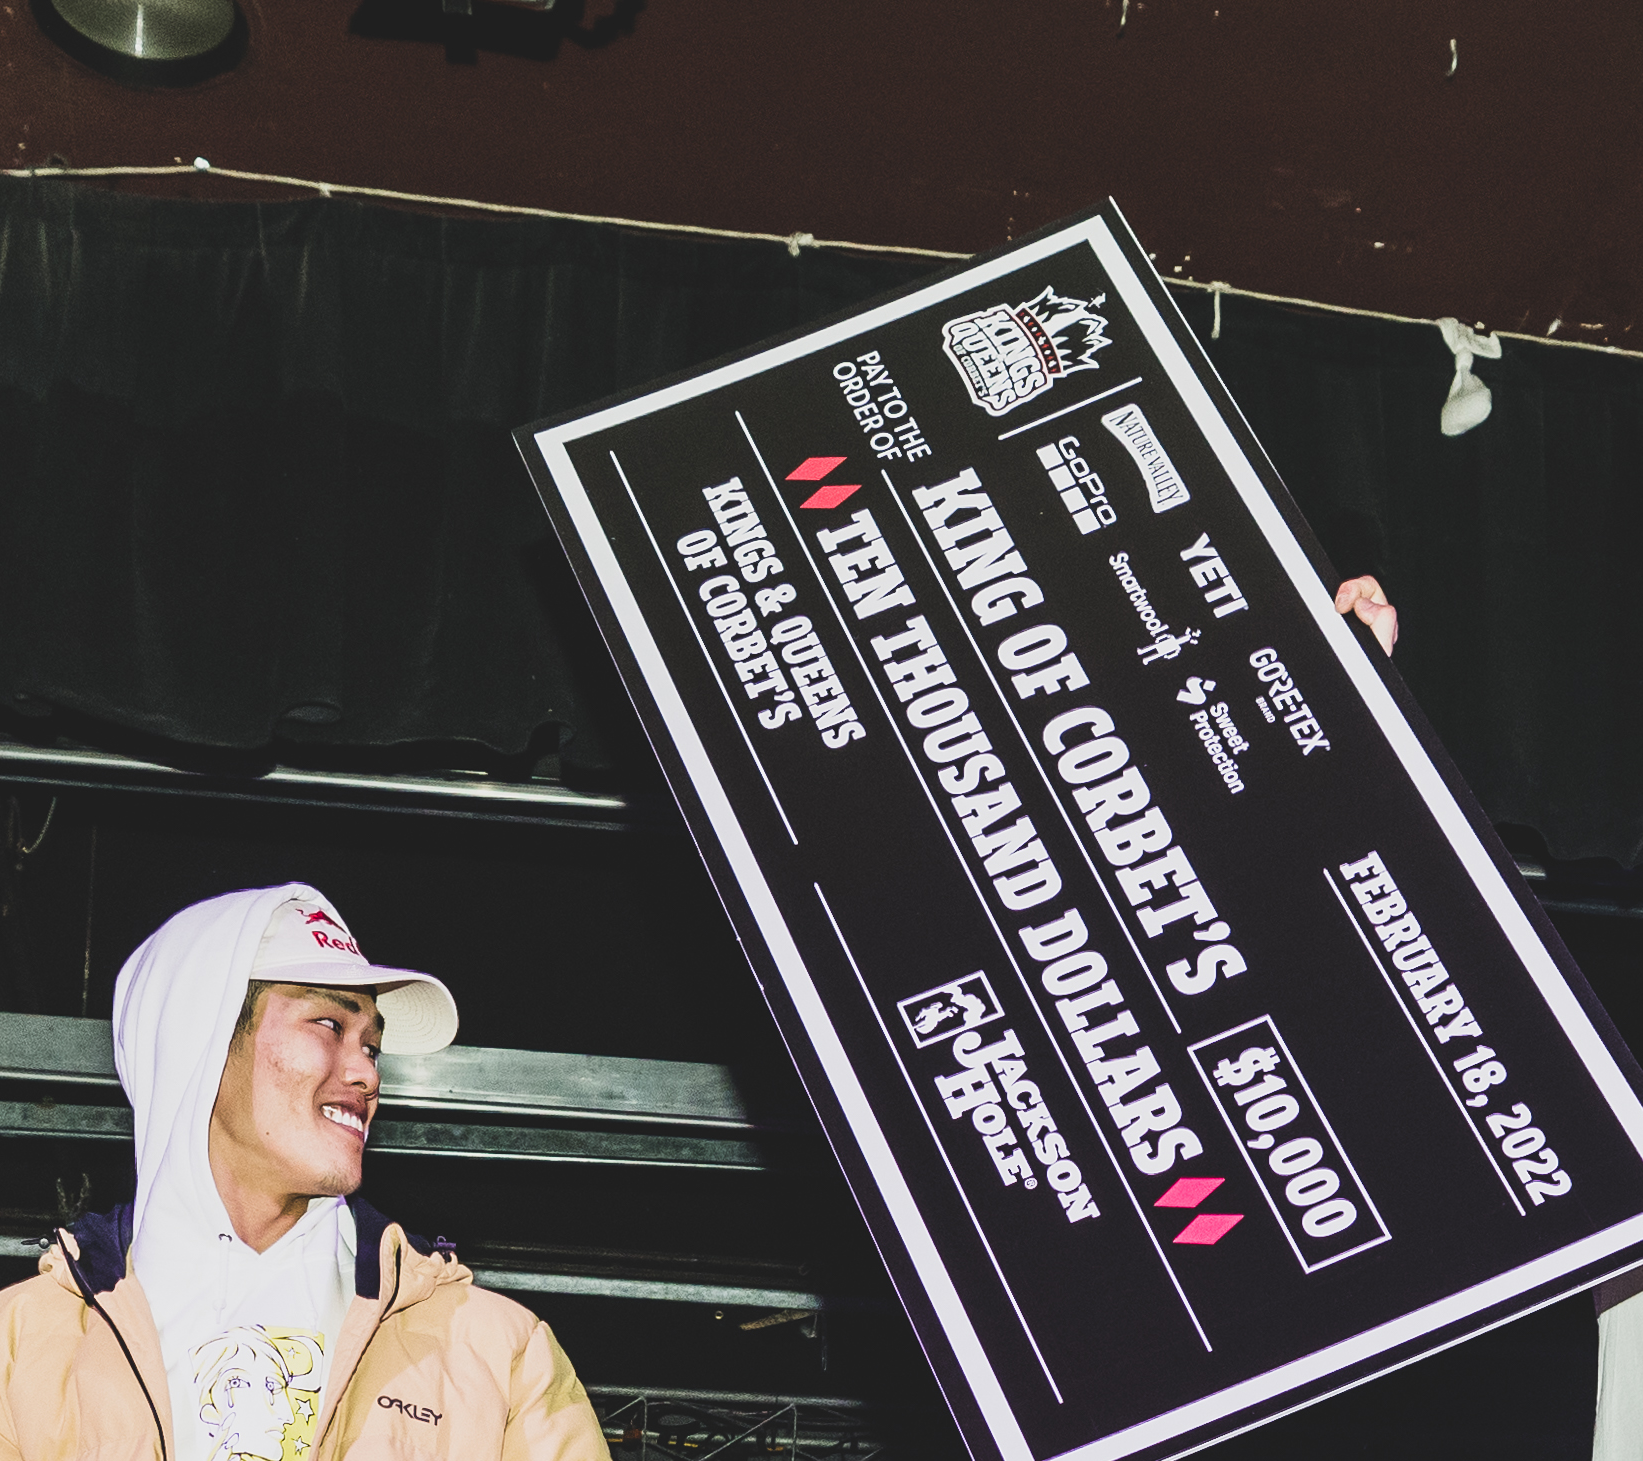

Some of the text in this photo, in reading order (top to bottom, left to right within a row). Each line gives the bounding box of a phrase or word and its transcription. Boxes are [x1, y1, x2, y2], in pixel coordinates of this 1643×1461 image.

[951, 322, 1016, 410] QUEENS
[953, 344, 989, 397] OF CORBET'S
[975, 311, 1046, 397] KINGS
[833, 362, 902, 459] ORDER OF
[857, 351, 932, 462] PAY TO THE
[1059, 436, 1116, 527] GoPro
[1109, 411, 1183, 504] NATURE VALLEY
[702, 477, 866, 748] KINGS & QUEENS
[1109, 553, 1169, 637] Smartwool
[1180, 533, 1247, 618] YETI
[677, 530, 802, 729] OF CORBET'S
[912, 467, 1247, 995] KING OF CORBET'S
[1210, 702, 1249, 754] Sweet
[1250, 648, 1330, 755] GORE-TEX
[1256, 697, 1275, 723] BRAND
[1190, 710, 1244, 794] Protection
[817, 509, 1203, 1175] TEN THOUSAND DOLLARS
[311, 931, 359, 955] Red
[1340, 851, 1572, 1206] FEBRUARY 18, 2022
[953, 1029, 1100, 1223] JACKSON
[1213, 1047, 1356, 1237] $10,000
[377, 1395, 443, 1426] OAKLEY
